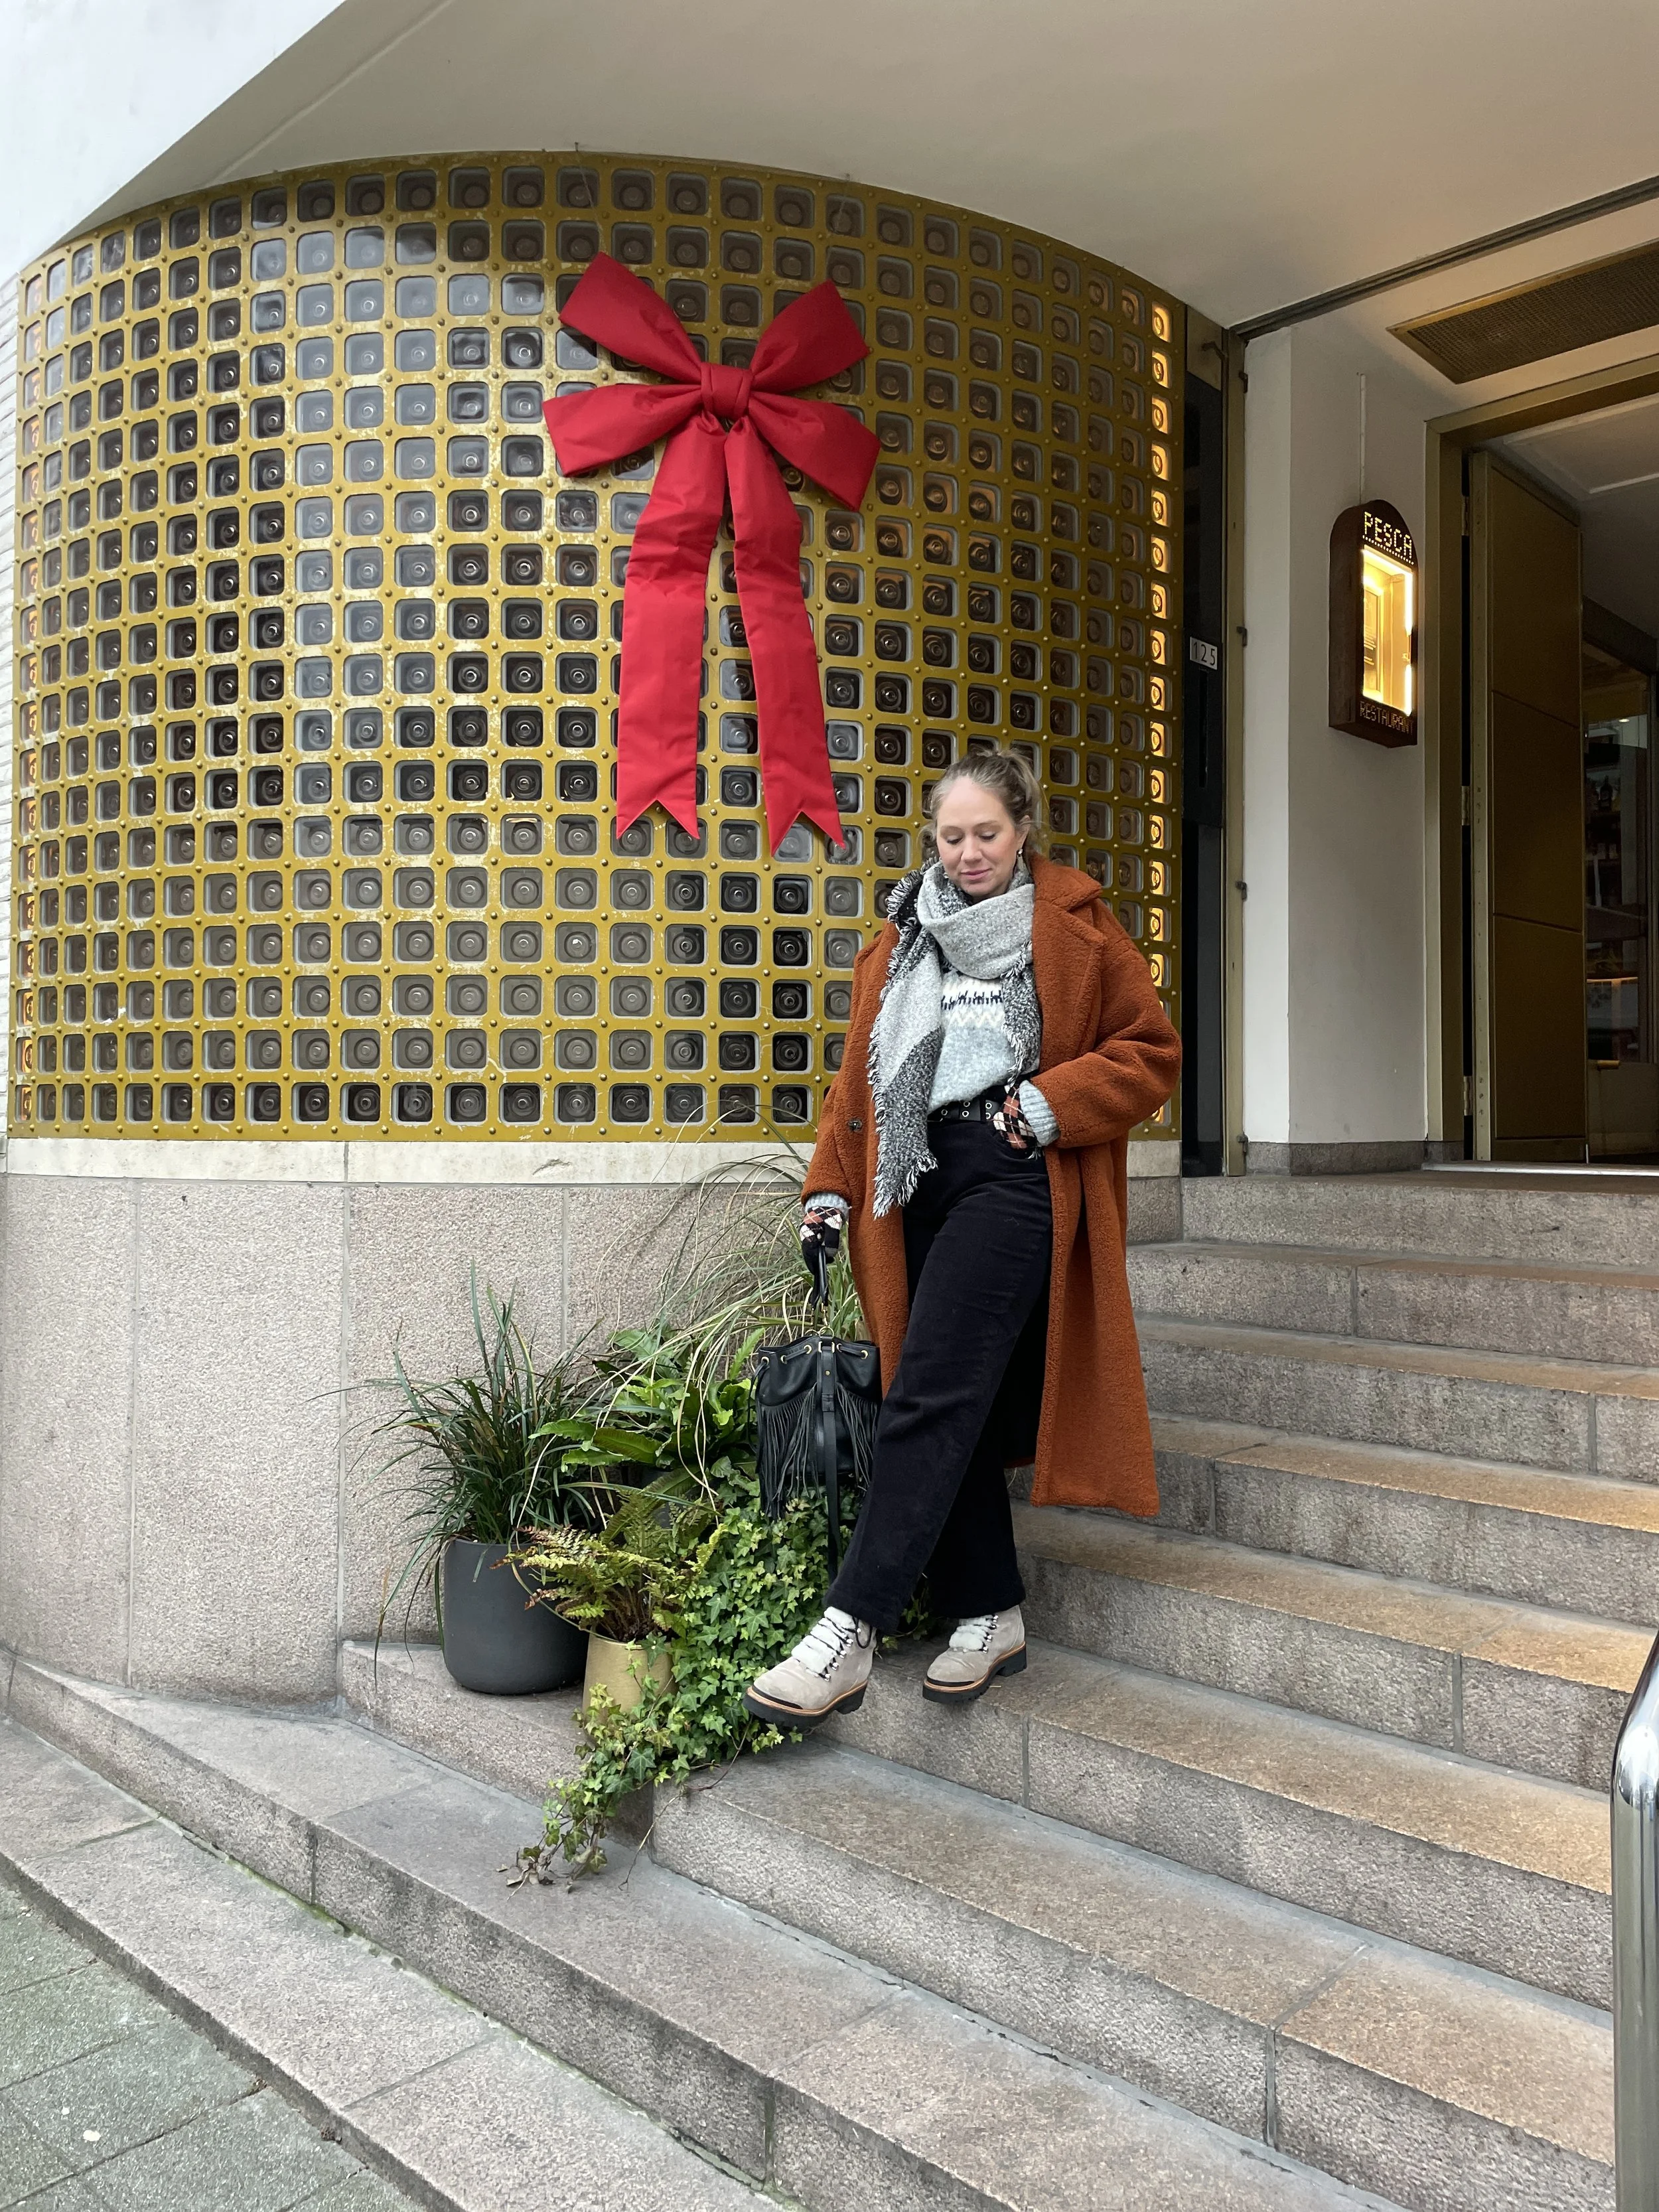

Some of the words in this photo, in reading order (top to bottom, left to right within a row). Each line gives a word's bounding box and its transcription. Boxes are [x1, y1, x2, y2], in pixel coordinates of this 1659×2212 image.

[1364, 511, 1412, 559] PESCA
[1193, 641, 1216, 666] 125
[1360, 700, 1413, 735] RESTAURANT
